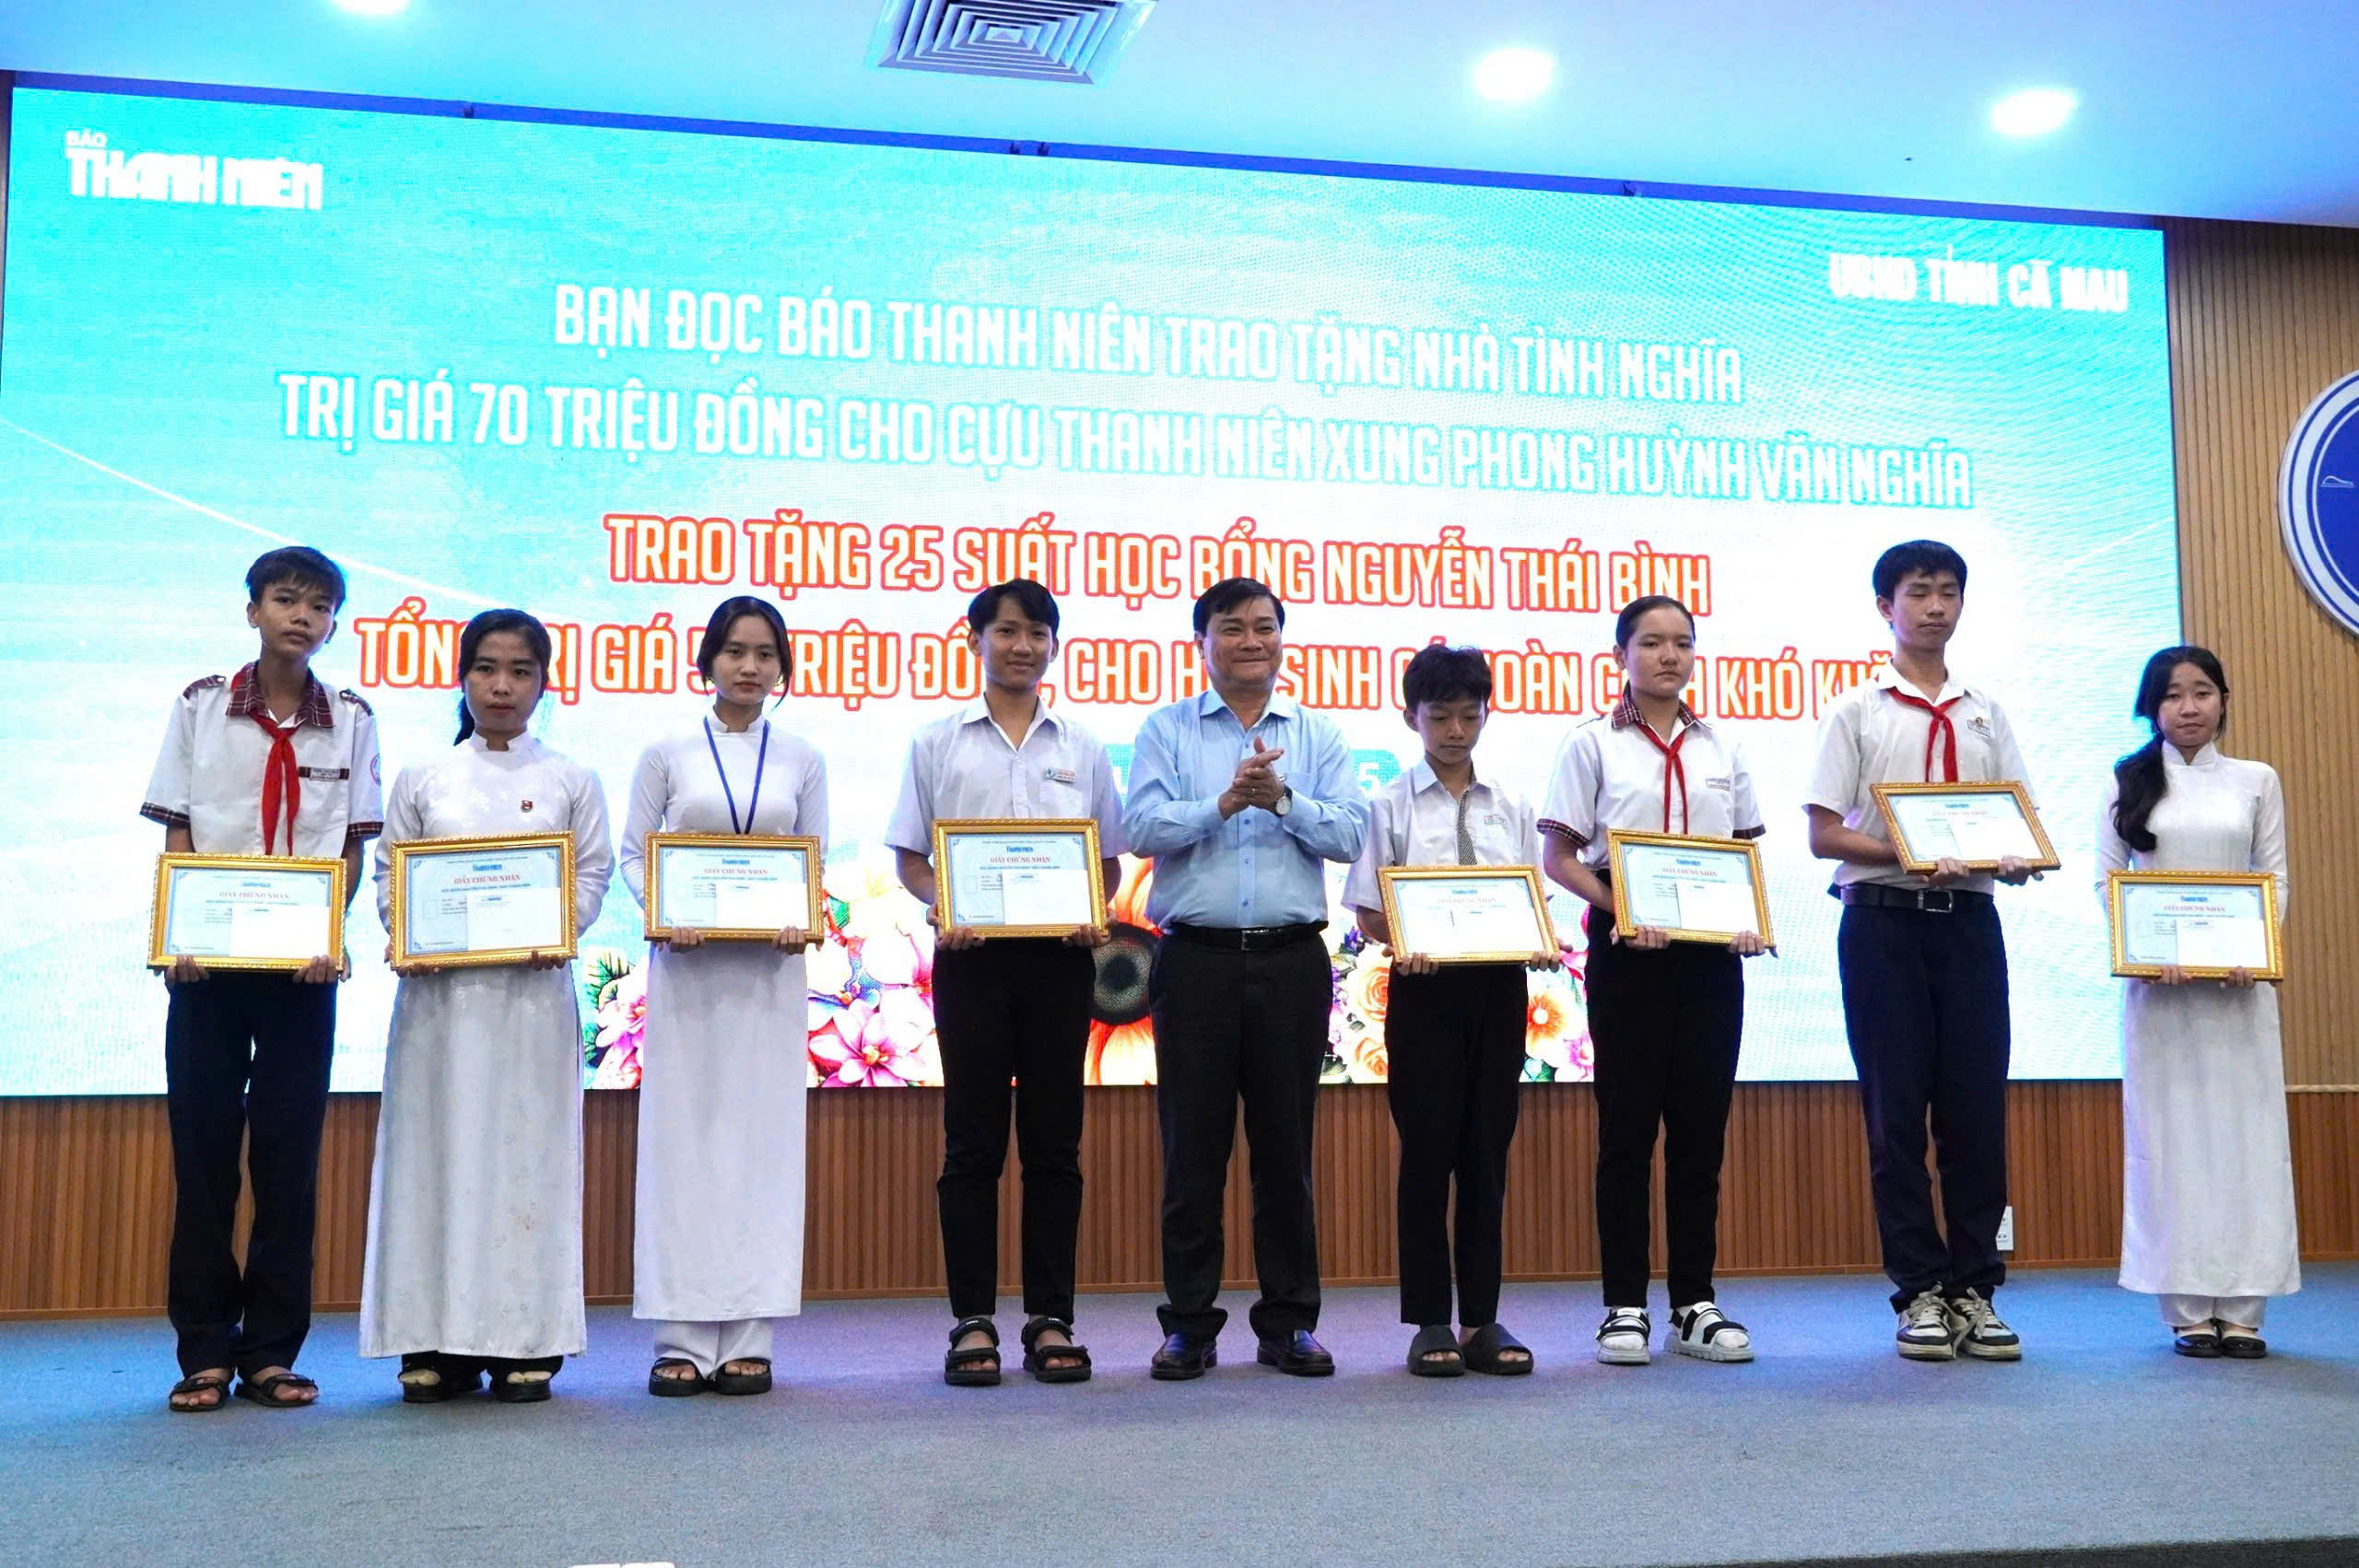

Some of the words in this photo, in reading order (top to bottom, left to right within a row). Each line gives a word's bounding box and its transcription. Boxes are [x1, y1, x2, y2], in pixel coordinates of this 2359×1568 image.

[555, 285, 651, 357] BẠN
[666, 289, 762, 363] ĐỌC
[779, 287, 872, 358] BÁO
[886, 301, 1038, 369] THANH
[1053, 302, 1152, 375] NIÊN
[1165, 315, 1278, 380] TRAO
[1290, 310, 1402, 397] TẶNG
[1413, 324, 1499, 392] NHÀ
[1512, 328, 1604, 396] TÌNH
[1619, 338, 1742, 404] NGHĨA
[279, 374, 357, 453] TRỊ
[372, 369, 455, 445] GIÁ
[469, 382, 530, 448] 70
[546, 377, 679, 462] TRIỆU
[692, 377, 825, 461] ĐỒNG
[839, 397, 933, 462] CHO
[948, 400, 1041, 479] CỰU
[1054, 407, 1202, 475] THANH
[1215, 405, 1313, 480] NIÊN
[1324, 418, 1441, 486] XUNG
[1452, 427, 1597, 491] PHONG
[1609, 427, 1747, 498] HUỲNH
[1758, 430, 1840, 503] VĂN
[1851, 440, 1973, 509] NGHĨA
[604, 514, 734, 584] TRAO
[744, 509, 870, 600] TẶNG
[879, 522, 944, 591] 25
[953, 511, 1076, 595] SUẤT
[1084, 532, 1181, 610] HỌC
[1190, 516, 1315, 603] BỔNG
[1322, 526, 1494, 611] NGUYỄN
[1501, 539, 1600, 613] THÁI
[1608, 539, 1710, 615] BÌNH
[355, 597, 461, 689] TỔN
[591, 614, 677, 693] GIÁ
[1064, 638, 1162, 704] CHO
[1276, 643, 1382, 711] SINH
[1715, 646, 1804, 720] KHÓ
